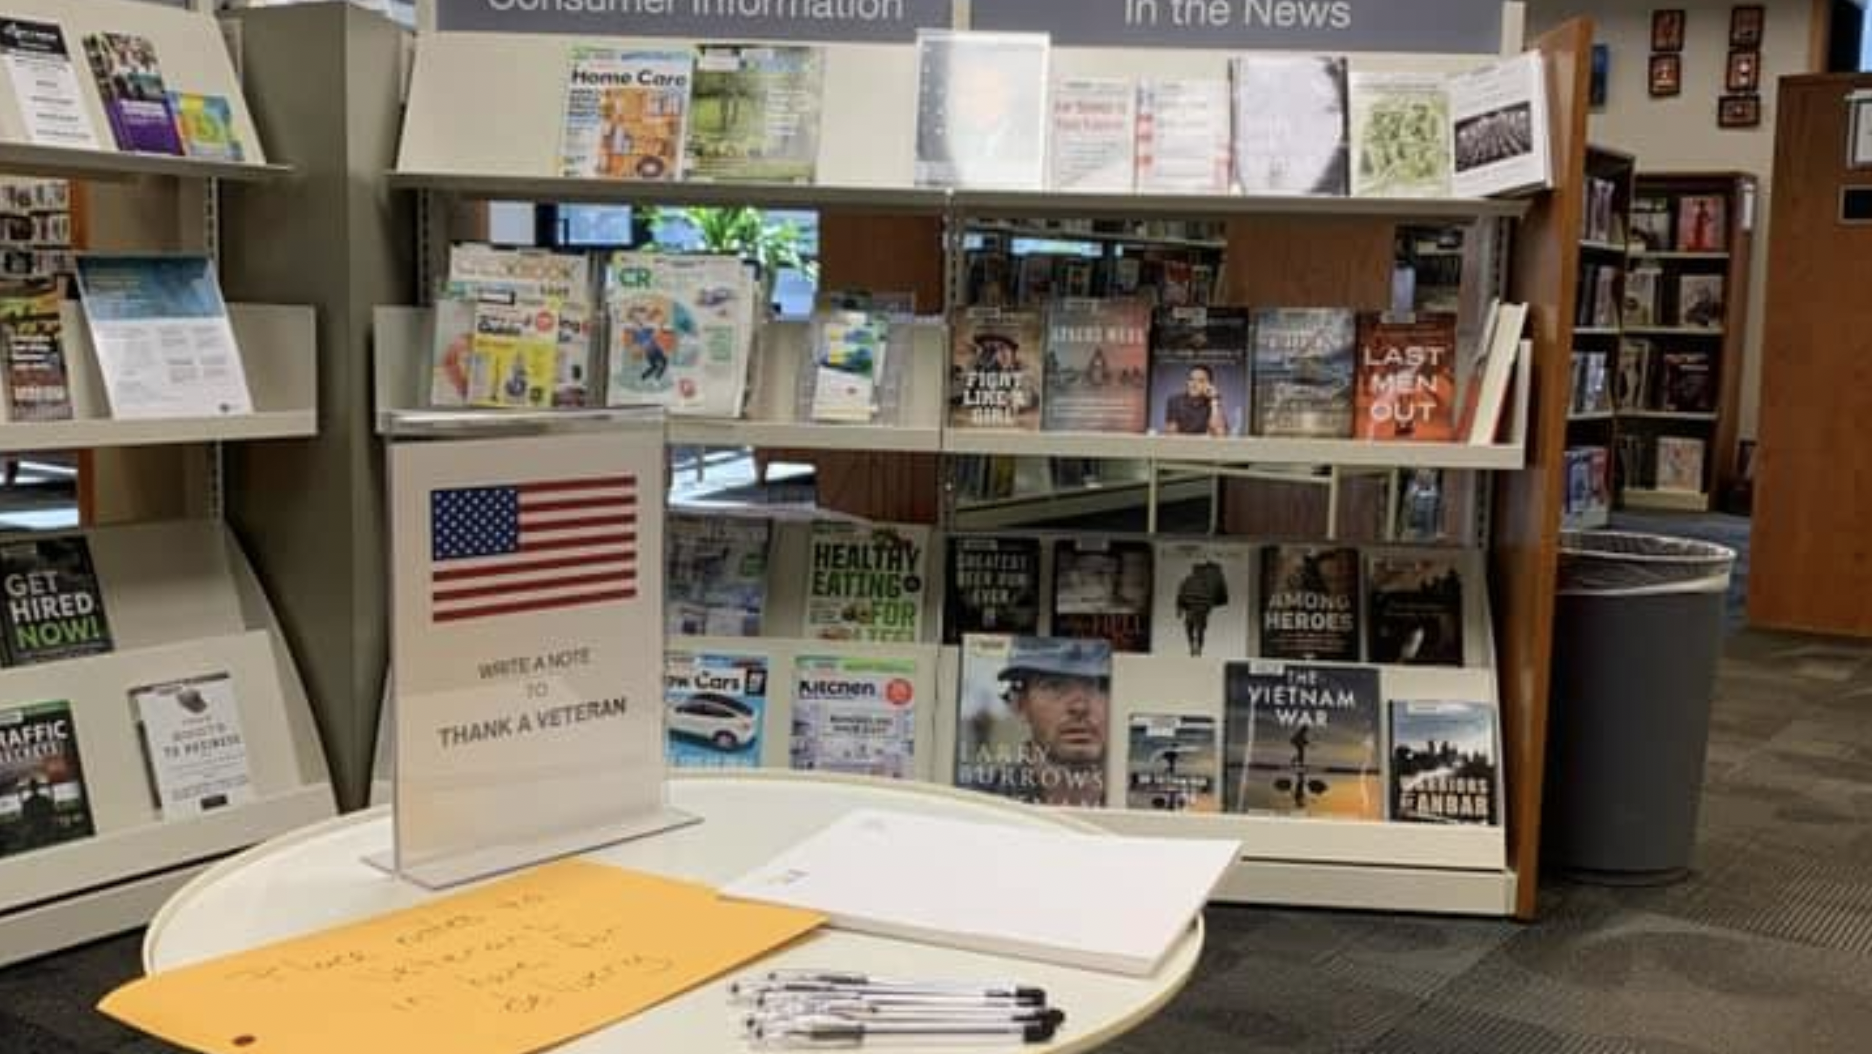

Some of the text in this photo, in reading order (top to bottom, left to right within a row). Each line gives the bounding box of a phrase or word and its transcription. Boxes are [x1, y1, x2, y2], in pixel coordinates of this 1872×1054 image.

[1125, 0, 1351, 28] In the News
[571, 67, 688, 87] Home Care
[618, 267, 653, 288] CR
[1363, 346, 1446, 366] LAST
[965, 371, 1022, 387] FIGHT
[1371, 374, 1437, 392] MEN
[963, 390, 1007, 405] LIKE
[1370, 402, 1437, 423] OUT
[814, 542, 921, 573] HEALTHY
[4, 571, 57, 597] GET
[811, 571, 901, 599] EATING
[8, 591, 94, 624] HIRED
[1268, 592, 1352, 612] AMONG
[872, 601, 915, 627] FOR
[1264, 611, 1354, 632] HEROES
[15, 615, 100, 649] NOW!
[478, 646, 592, 680] WRITE A NOTE
[694, 672, 740, 691] Cars
[1287, 669, 1317, 685] THE
[526, 682, 550, 700] TO
[1248, 685, 1356, 708] VIETNAM
[437, 697, 629, 750] THANK A VETERAN
[1275, 708, 1329, 727] WAR
[958, 763, 1106, 790] BURROWS
[1398, 776, 1488, 794] RRIORS
[1418, 793, 1489, 816] ANBAR
